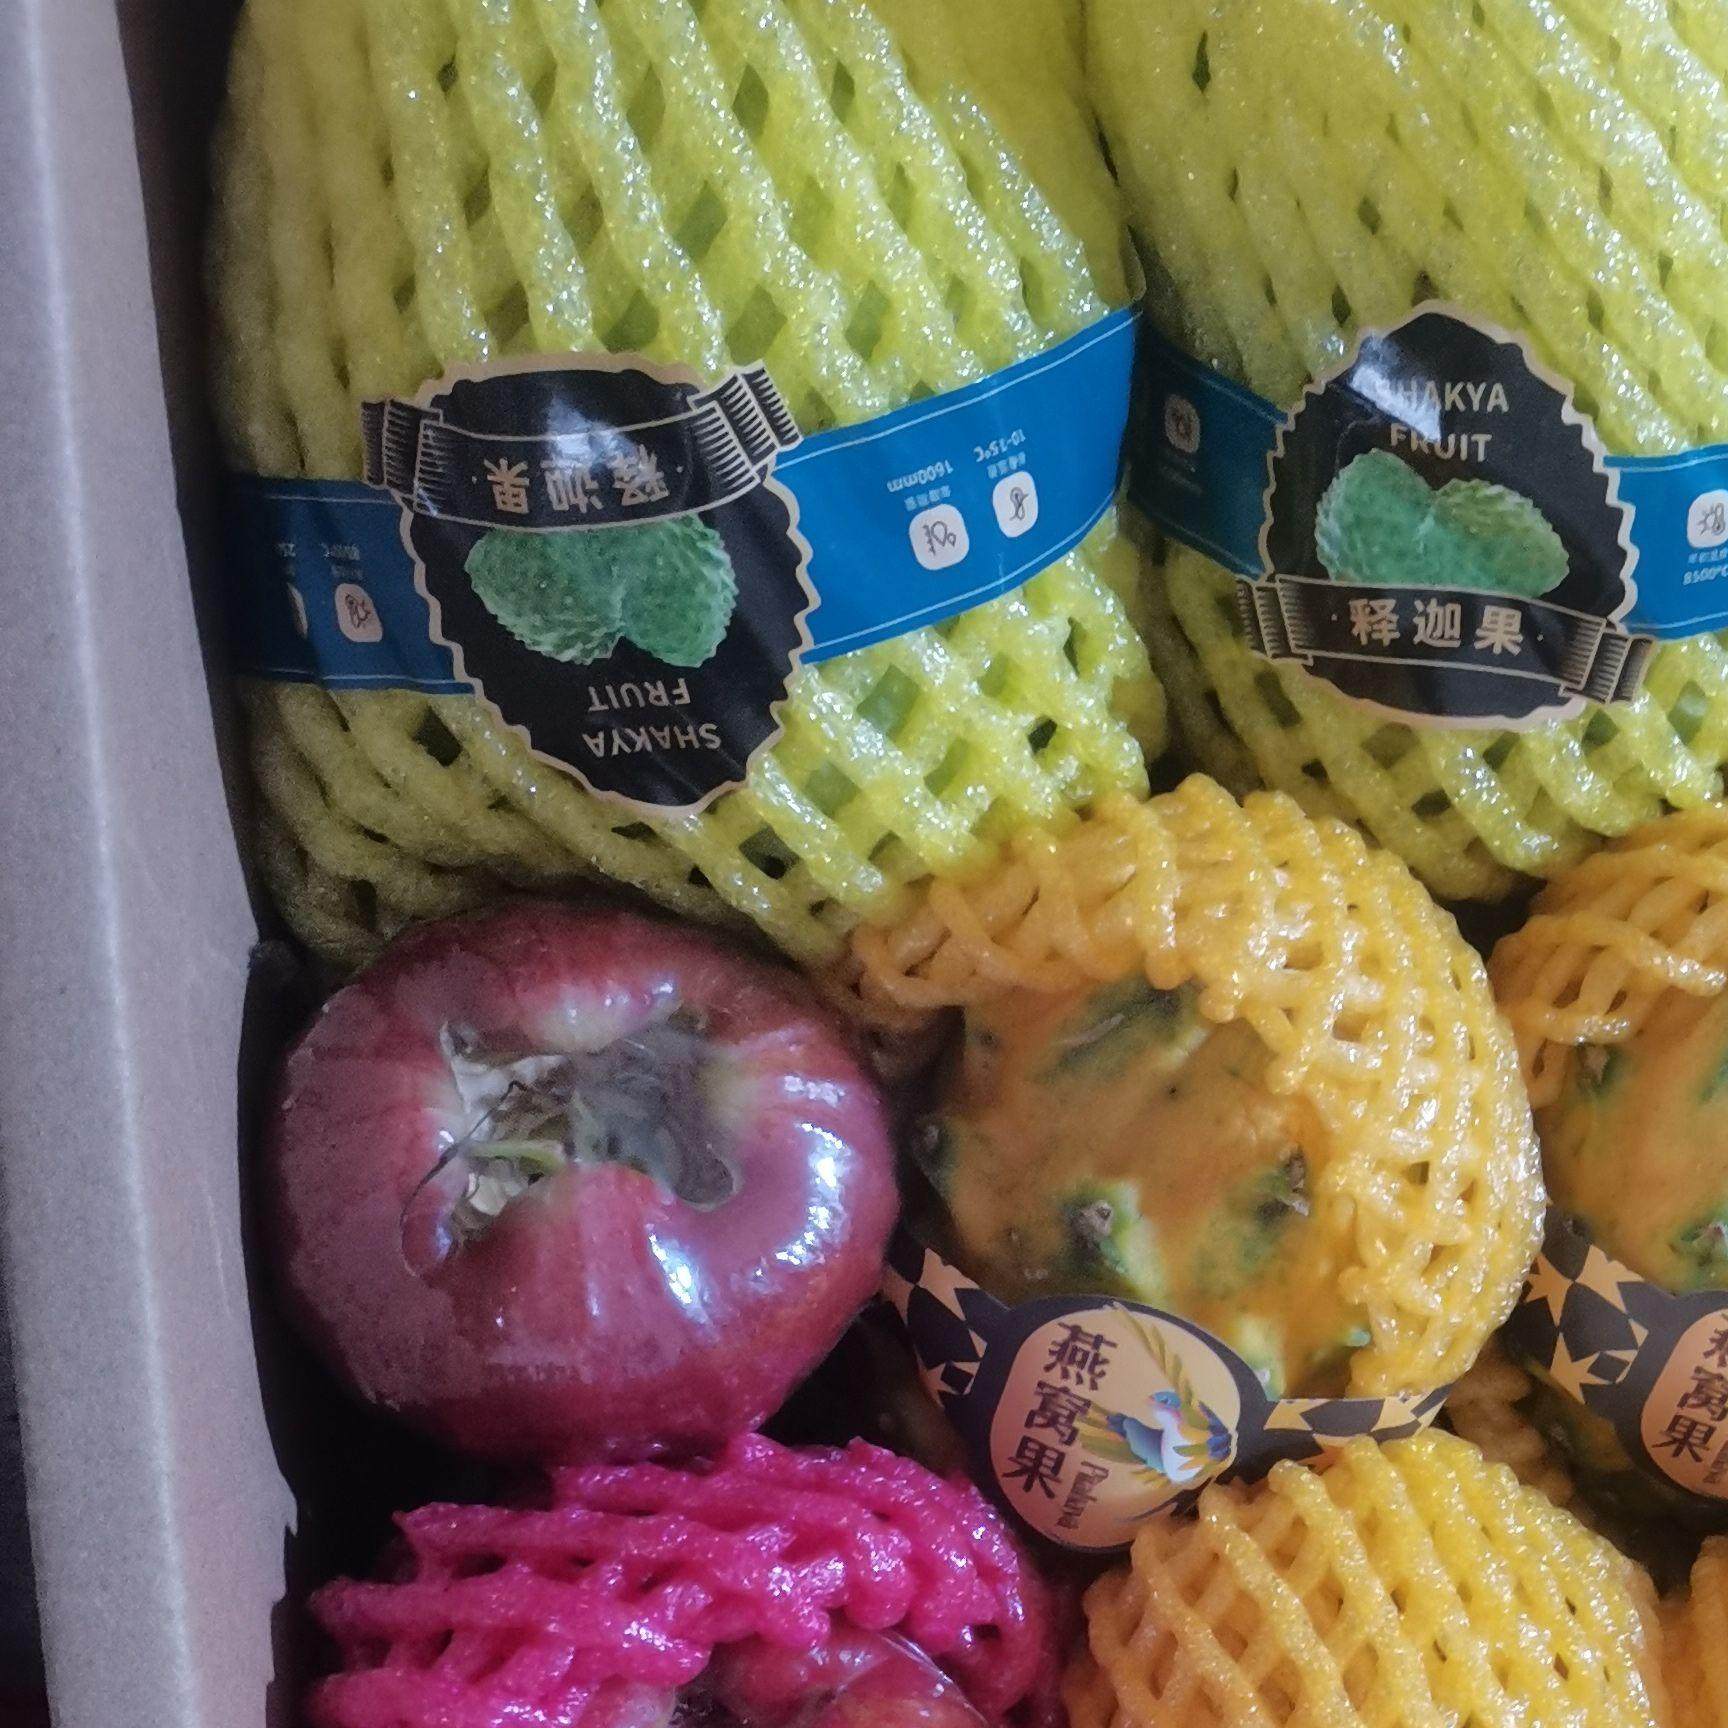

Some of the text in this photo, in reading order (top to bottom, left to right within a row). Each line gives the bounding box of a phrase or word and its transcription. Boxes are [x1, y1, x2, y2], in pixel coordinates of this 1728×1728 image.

[1384, 378, 1510, 413] HAKYA
[1390, 422, 1493, 463] FRUIT
[886, 459, 954, 493] 1600mm
[1349, 598, 1524, 656] 释迦果
[587, 677, 691, 713] FRUIT
[582, 722, 722, 758] SHAKYA
